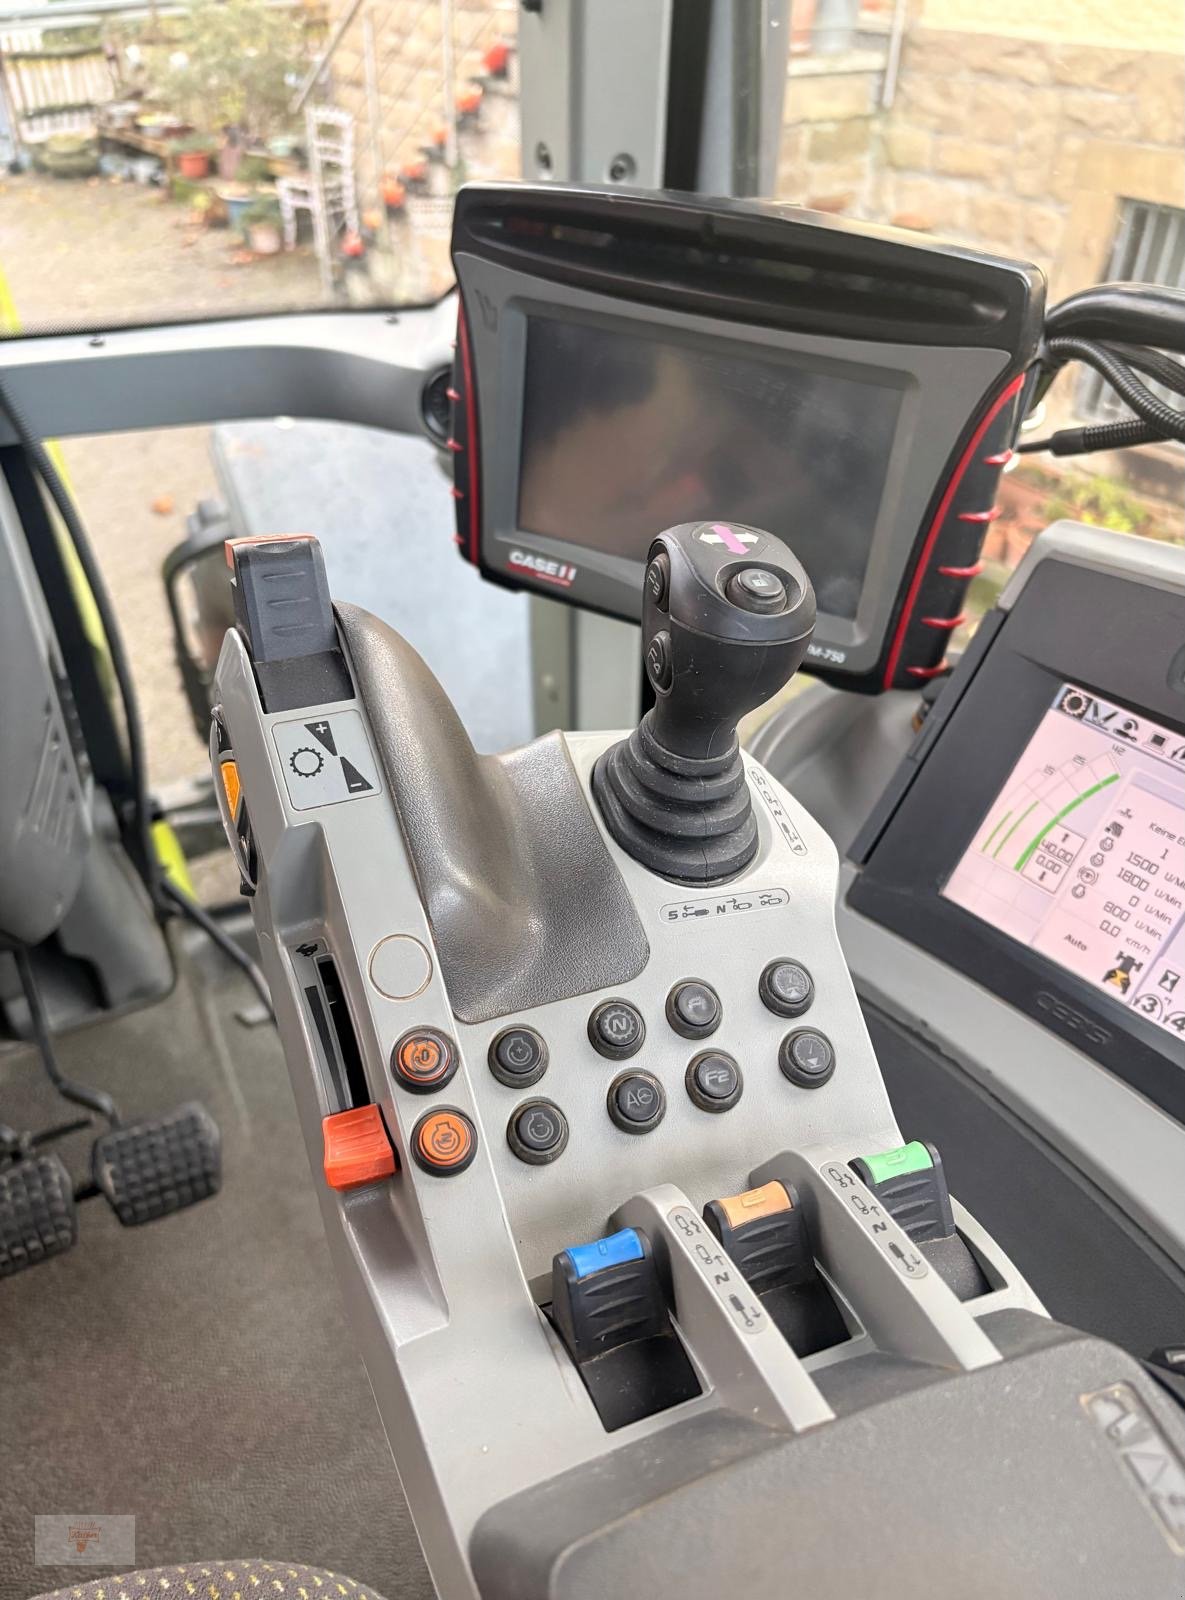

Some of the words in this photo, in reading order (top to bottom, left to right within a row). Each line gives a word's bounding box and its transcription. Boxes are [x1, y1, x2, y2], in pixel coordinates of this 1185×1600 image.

[509, 550, 559, 575] CASE
[1035, 854, 1062, 875] 0.00
[1126, 851, 1160, 875] 1500
[1117, 867, 1150, 892] 1800
[1064, 934, 1088, 952] Auto
[1141, 996, 1158, 1014] 3
[612, 1017, 627, 1032] N
[705, 1068, 730, 1086] F2
[872, 1222, 887, 1233] N
[715, 1272, 730, 1285] N
